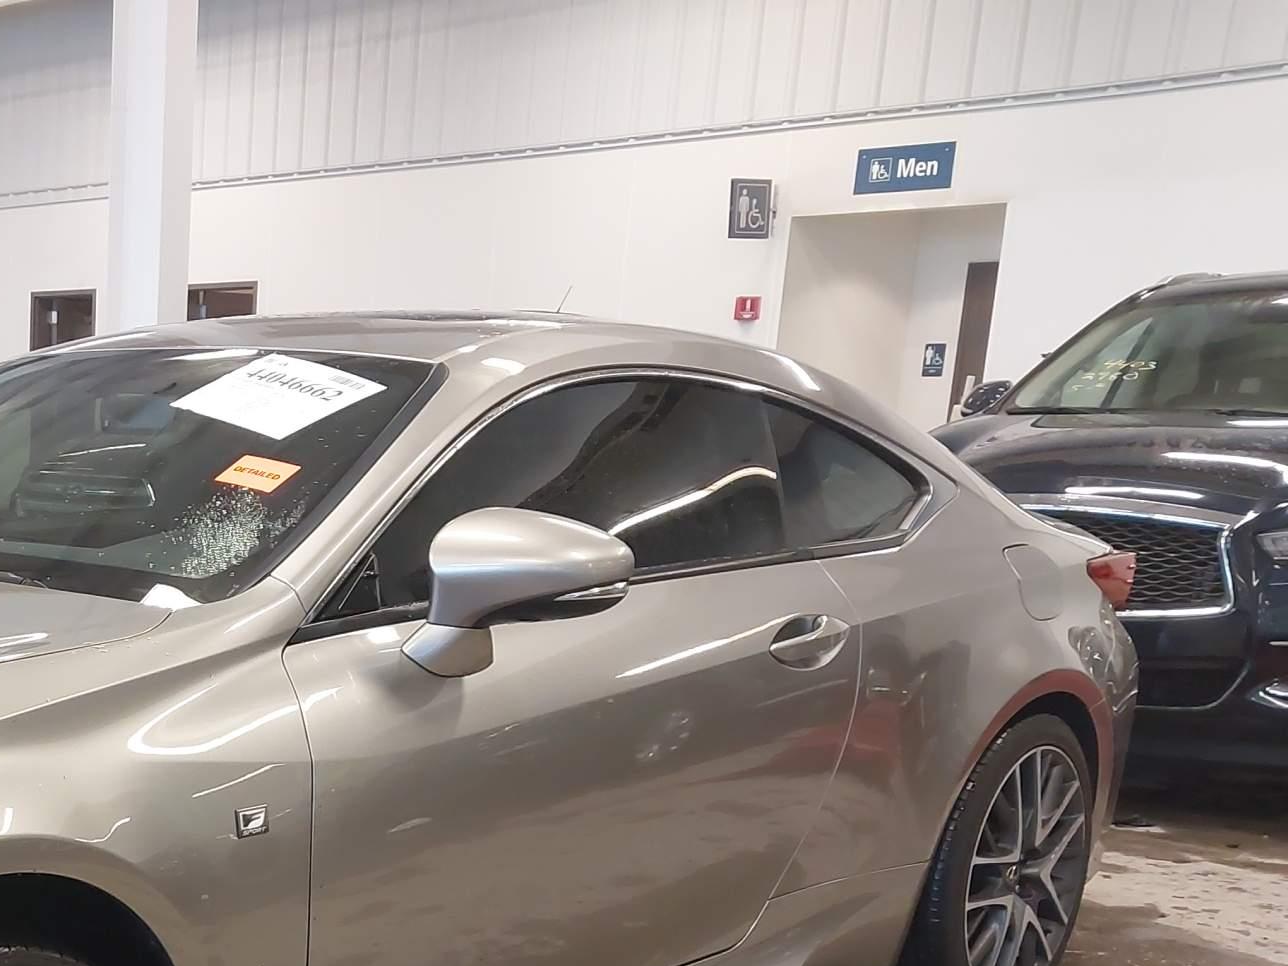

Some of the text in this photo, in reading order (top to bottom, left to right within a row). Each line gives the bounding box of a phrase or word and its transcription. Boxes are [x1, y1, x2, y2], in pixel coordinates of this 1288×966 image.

[896, 158, 939, 178] Men
[247, 368, 343, 400] 44046662
[233, 465, 281, 481] DETAILED
